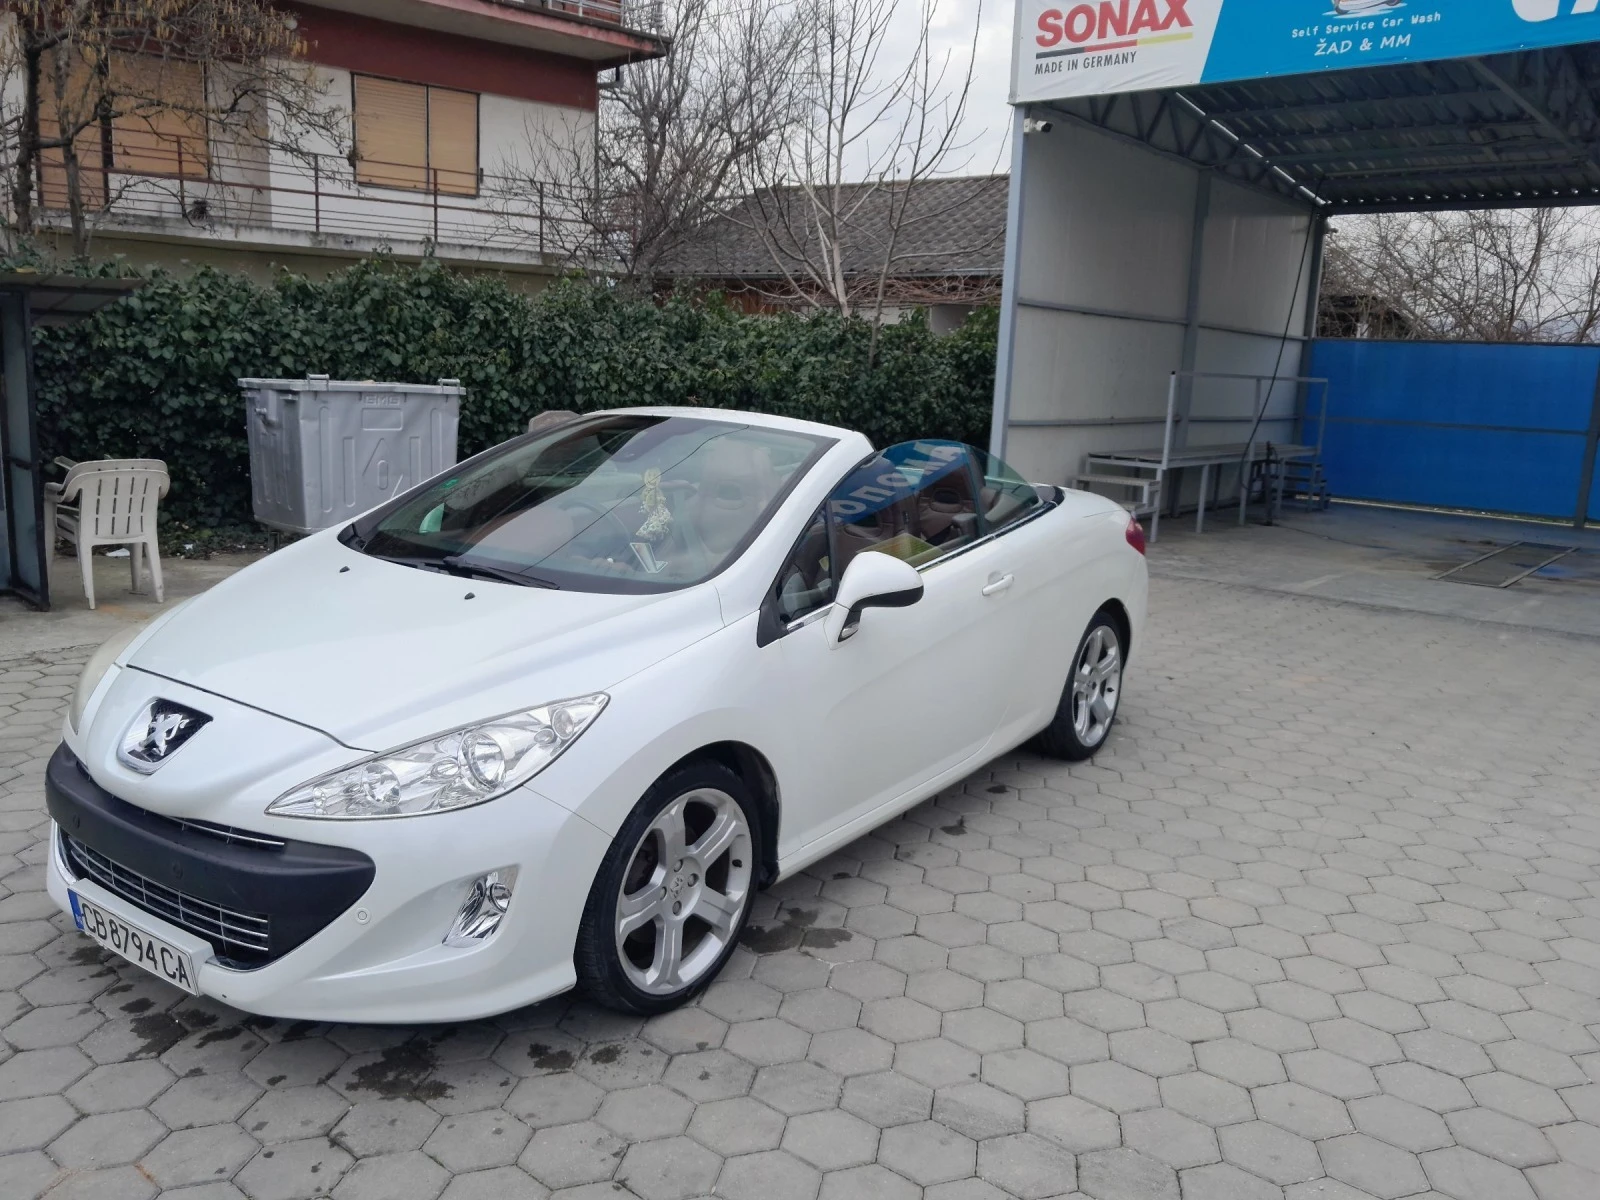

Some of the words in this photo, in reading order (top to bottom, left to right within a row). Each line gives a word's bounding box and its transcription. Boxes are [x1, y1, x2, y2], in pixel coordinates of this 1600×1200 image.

[1035, 0, 1194, 48] SONAX
[1291, 25, 1319, 38] Self
[1325, 20, 1375, 35] Service
[1382, 17, 1404, 28] Car
[1411, 11, 1441, 25] Wash
[1314, 38, 1352, 57] ŽAD
[1359, 38, 1373, 51] &
[1379, 33, 1412, 49] MM
[1034, 60, 1063, 75] MADE
[1067, 58, 1079, 71] IN
[1083, 51, 1137, 69] GERMANY
